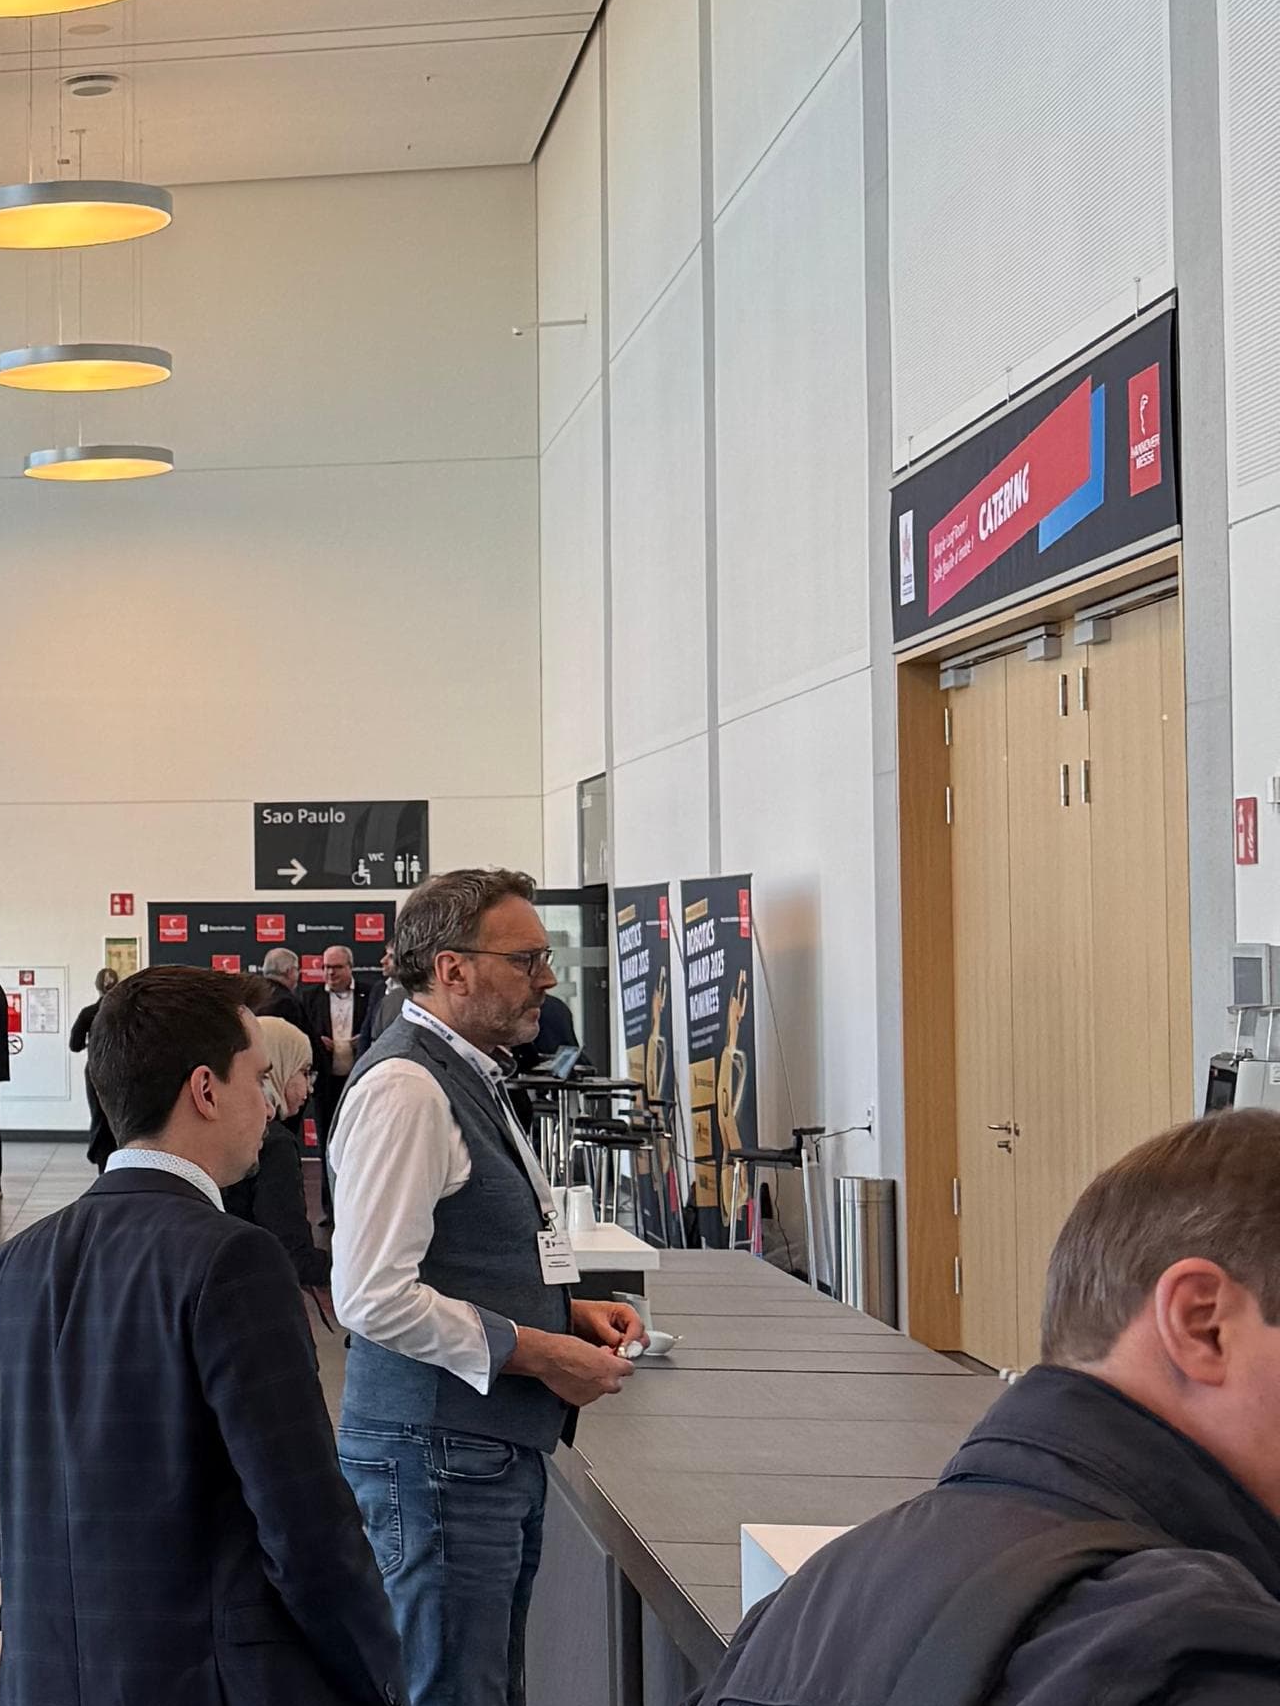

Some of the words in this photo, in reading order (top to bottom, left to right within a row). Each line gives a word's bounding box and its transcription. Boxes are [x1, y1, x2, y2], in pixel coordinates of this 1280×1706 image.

[978, 461, 1030, 541] CATERING
[262, 808, 294, 824] Sao
[297, 806, 346, 824] Paulo
[367, 852, 385, 862] WC
[686, 917, 715, 957] ROBOTICS
[688, 955, 710, 989] AWARD
[710, 948, 725, 980] 2025
[689, 985, 719, 1022] NOMINEES
